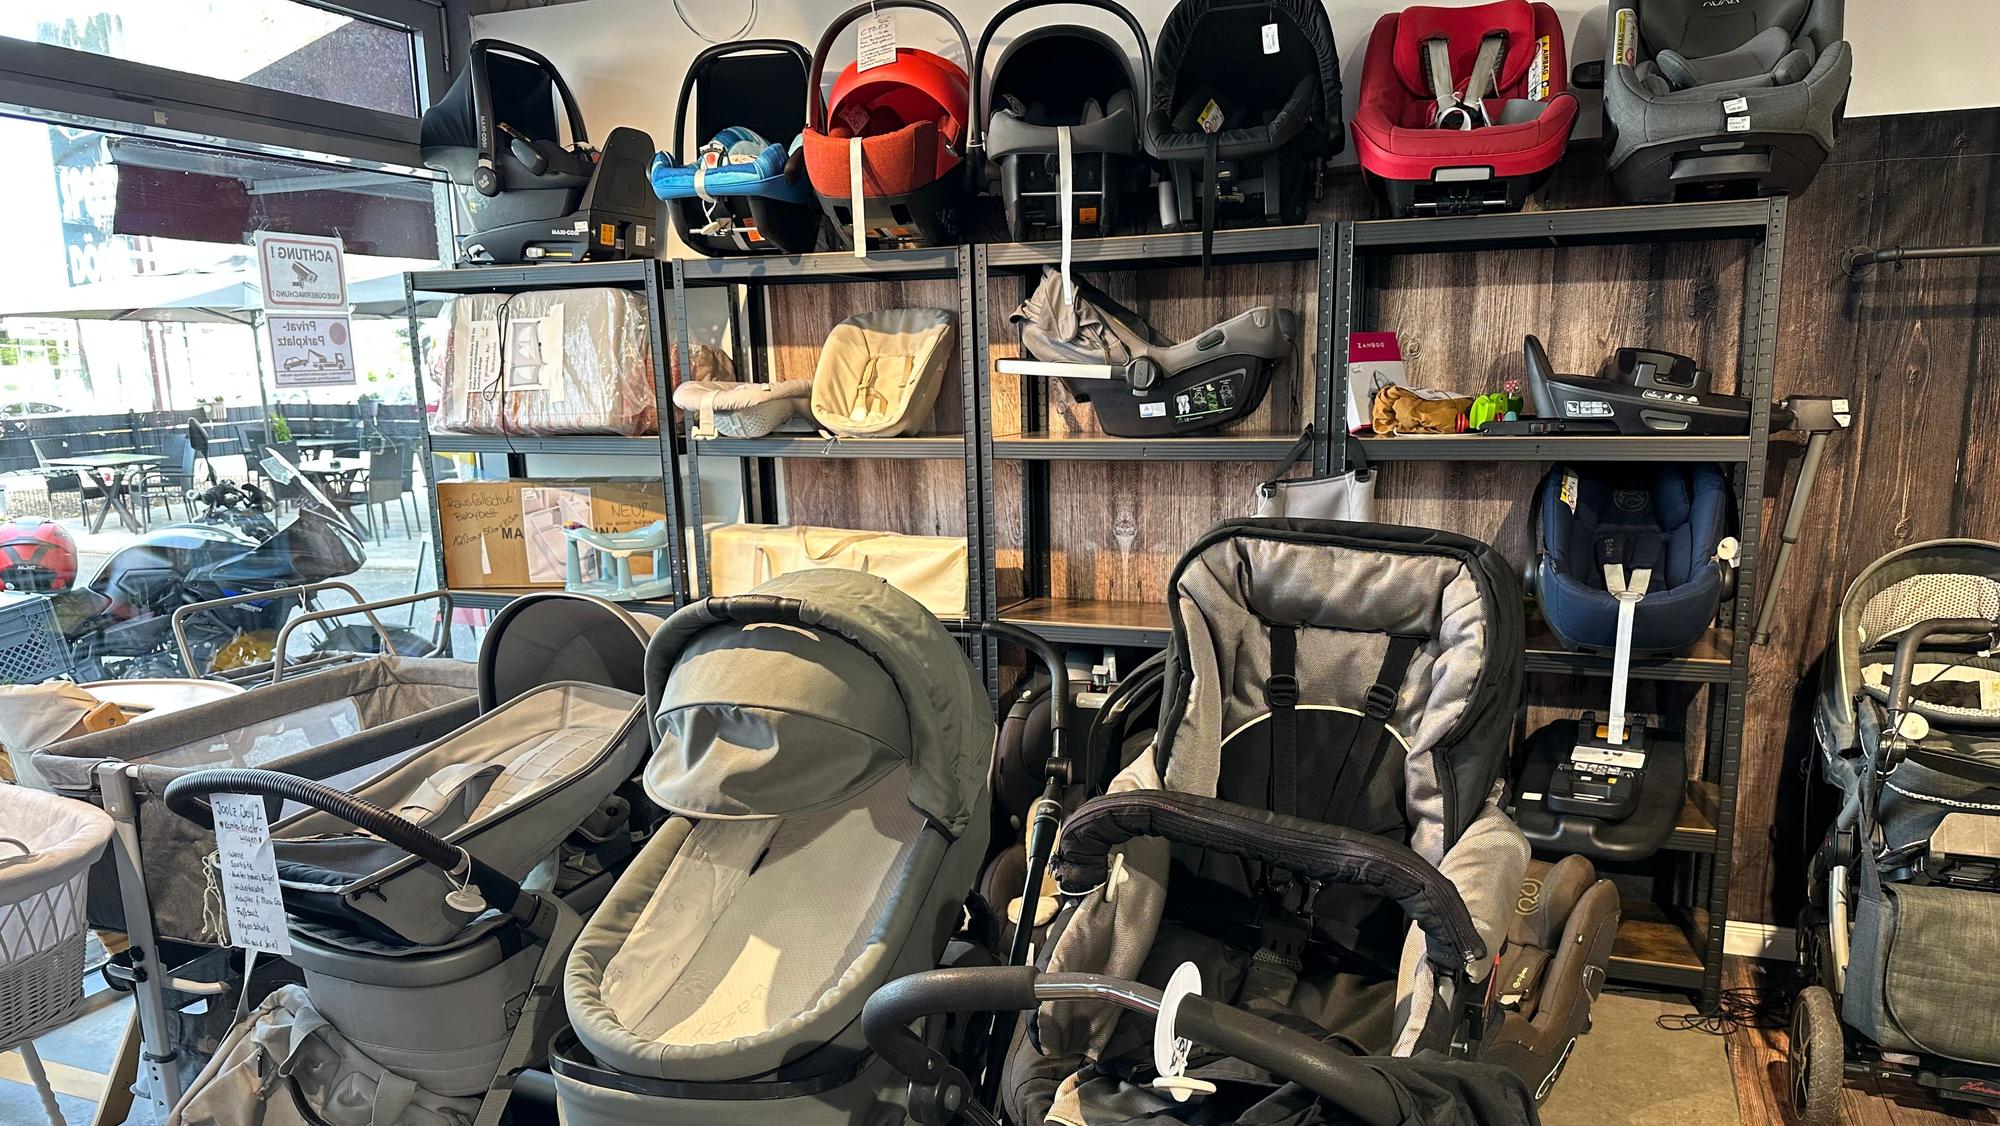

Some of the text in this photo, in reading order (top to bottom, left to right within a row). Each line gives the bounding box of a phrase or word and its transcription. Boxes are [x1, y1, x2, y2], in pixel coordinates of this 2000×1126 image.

[1356, 341, 1385, 350] ZAMBOO
[215, 801, 237, 817] Joolz
[255, 803, 262, 820] 2
